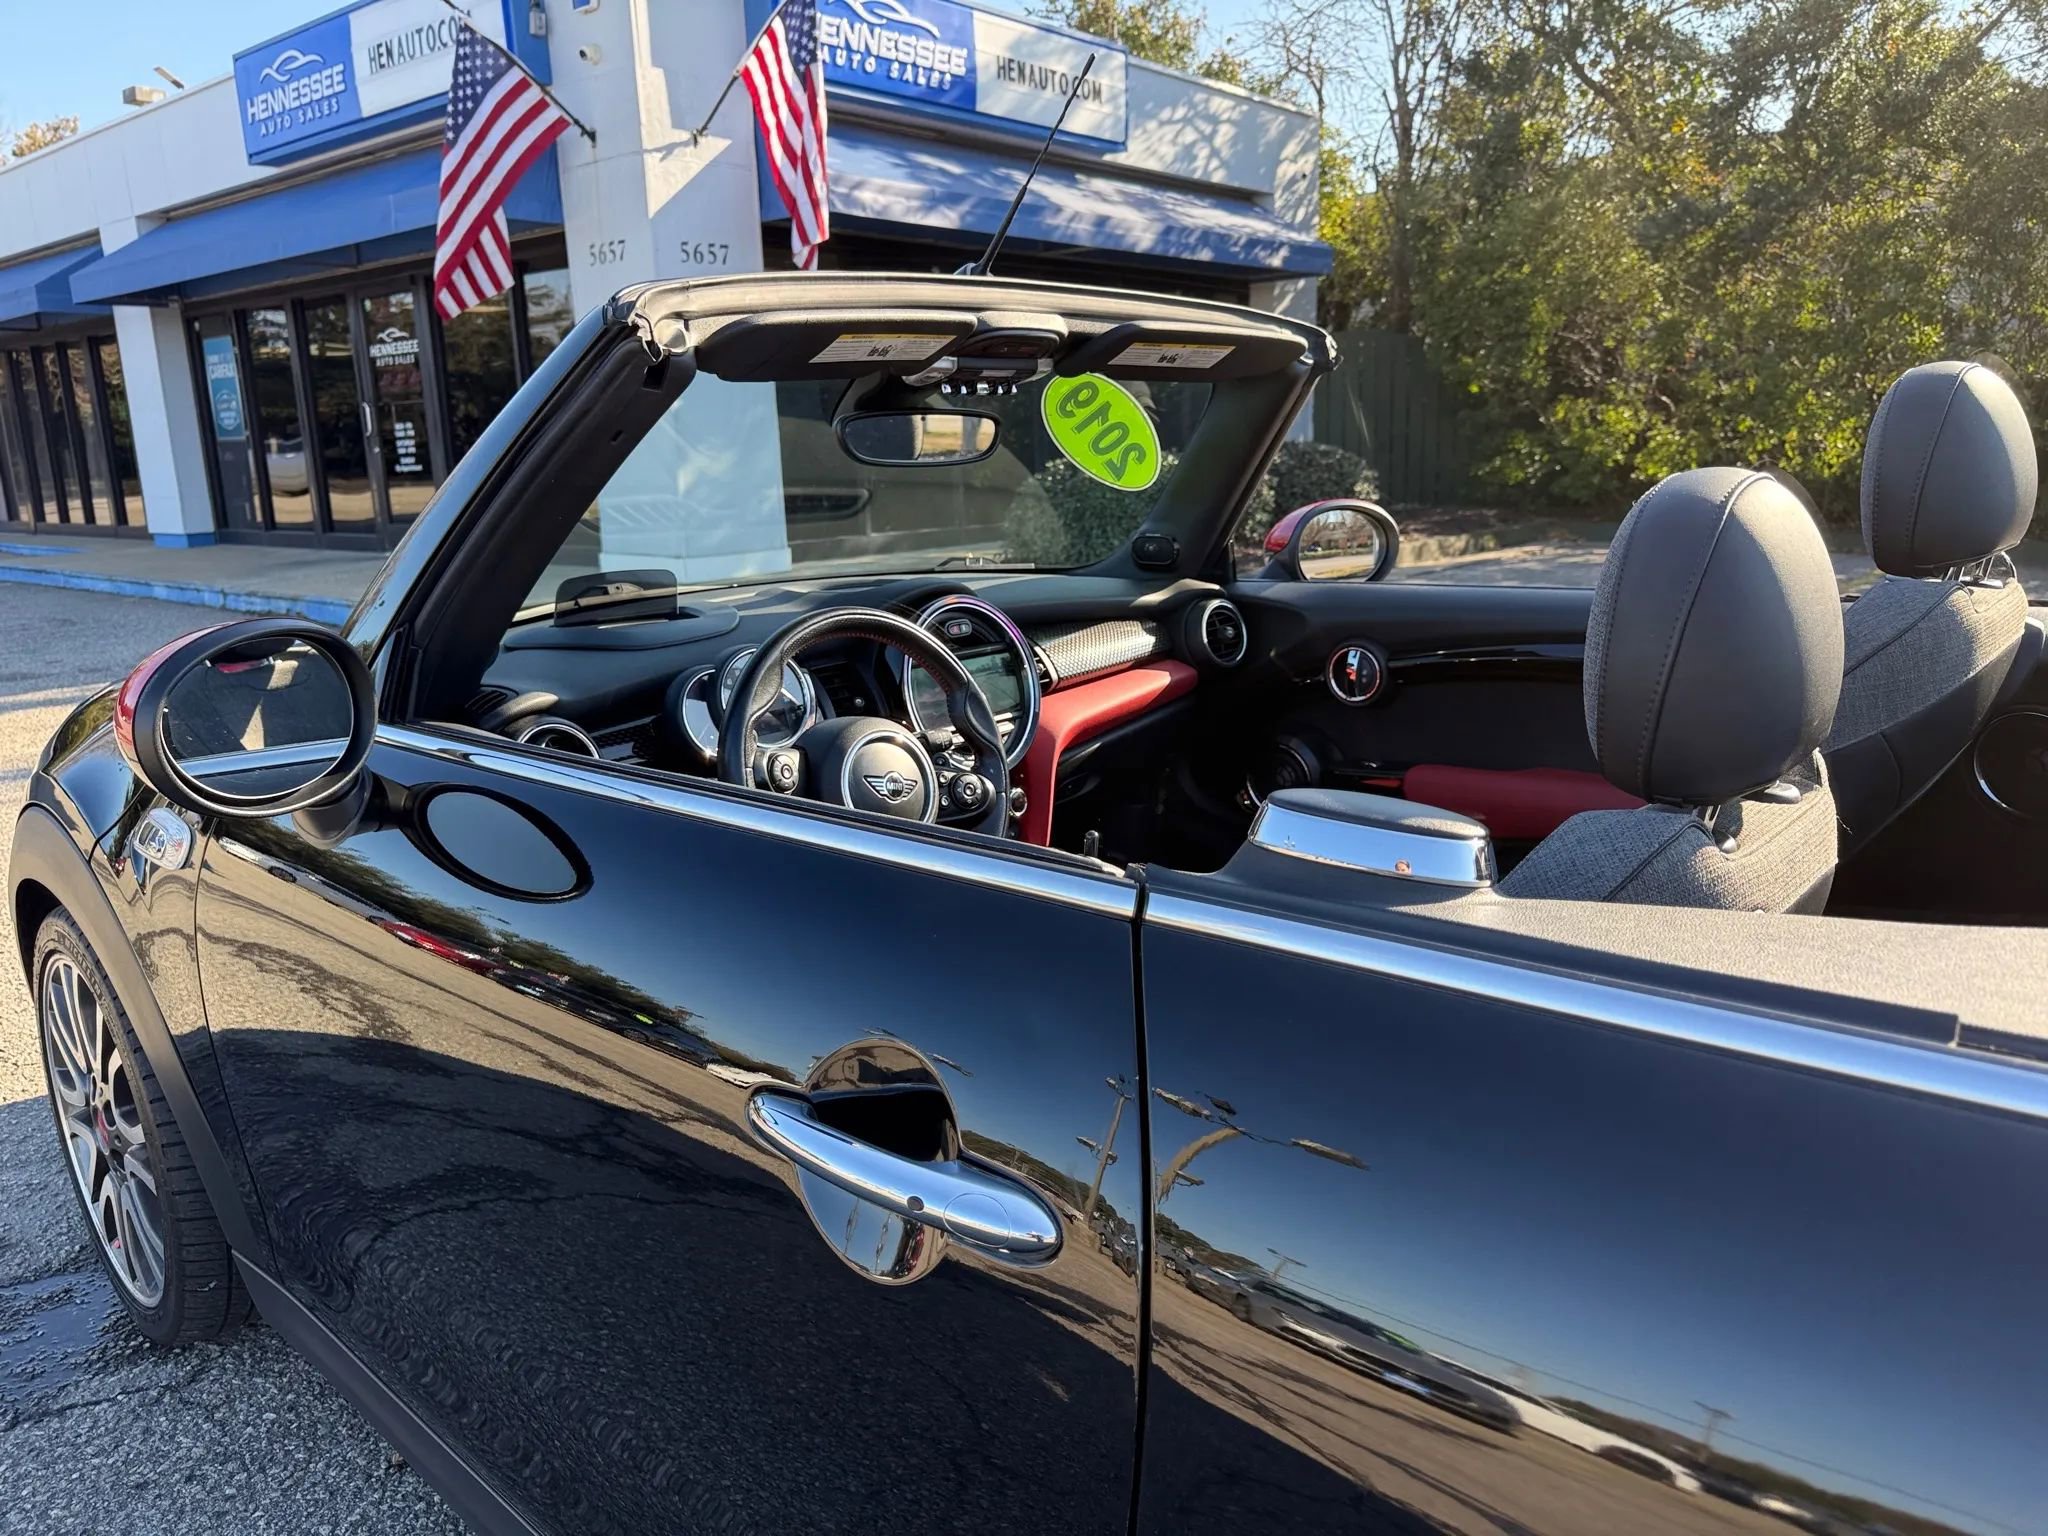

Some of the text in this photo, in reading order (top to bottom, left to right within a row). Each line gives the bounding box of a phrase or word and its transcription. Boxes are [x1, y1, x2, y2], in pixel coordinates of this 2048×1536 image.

[368, 10, 471, 75] HENAUTO.CO
[889, 61, 952, 91] SALES
[996, 55, 1103, 104] HENAUTOCOM
[247, 63, 345, 125] HENNESSEE
[260, 98, 338, 137] AUTO SALES
[589, 239, 625, 266] 5657
[680, 241, 729, 265] 5657
[369, 339, 420, 357] HENNESSEE
[376, 353, 415, 367] AUTO SALES
[886, 782, 903, 791] MINI
